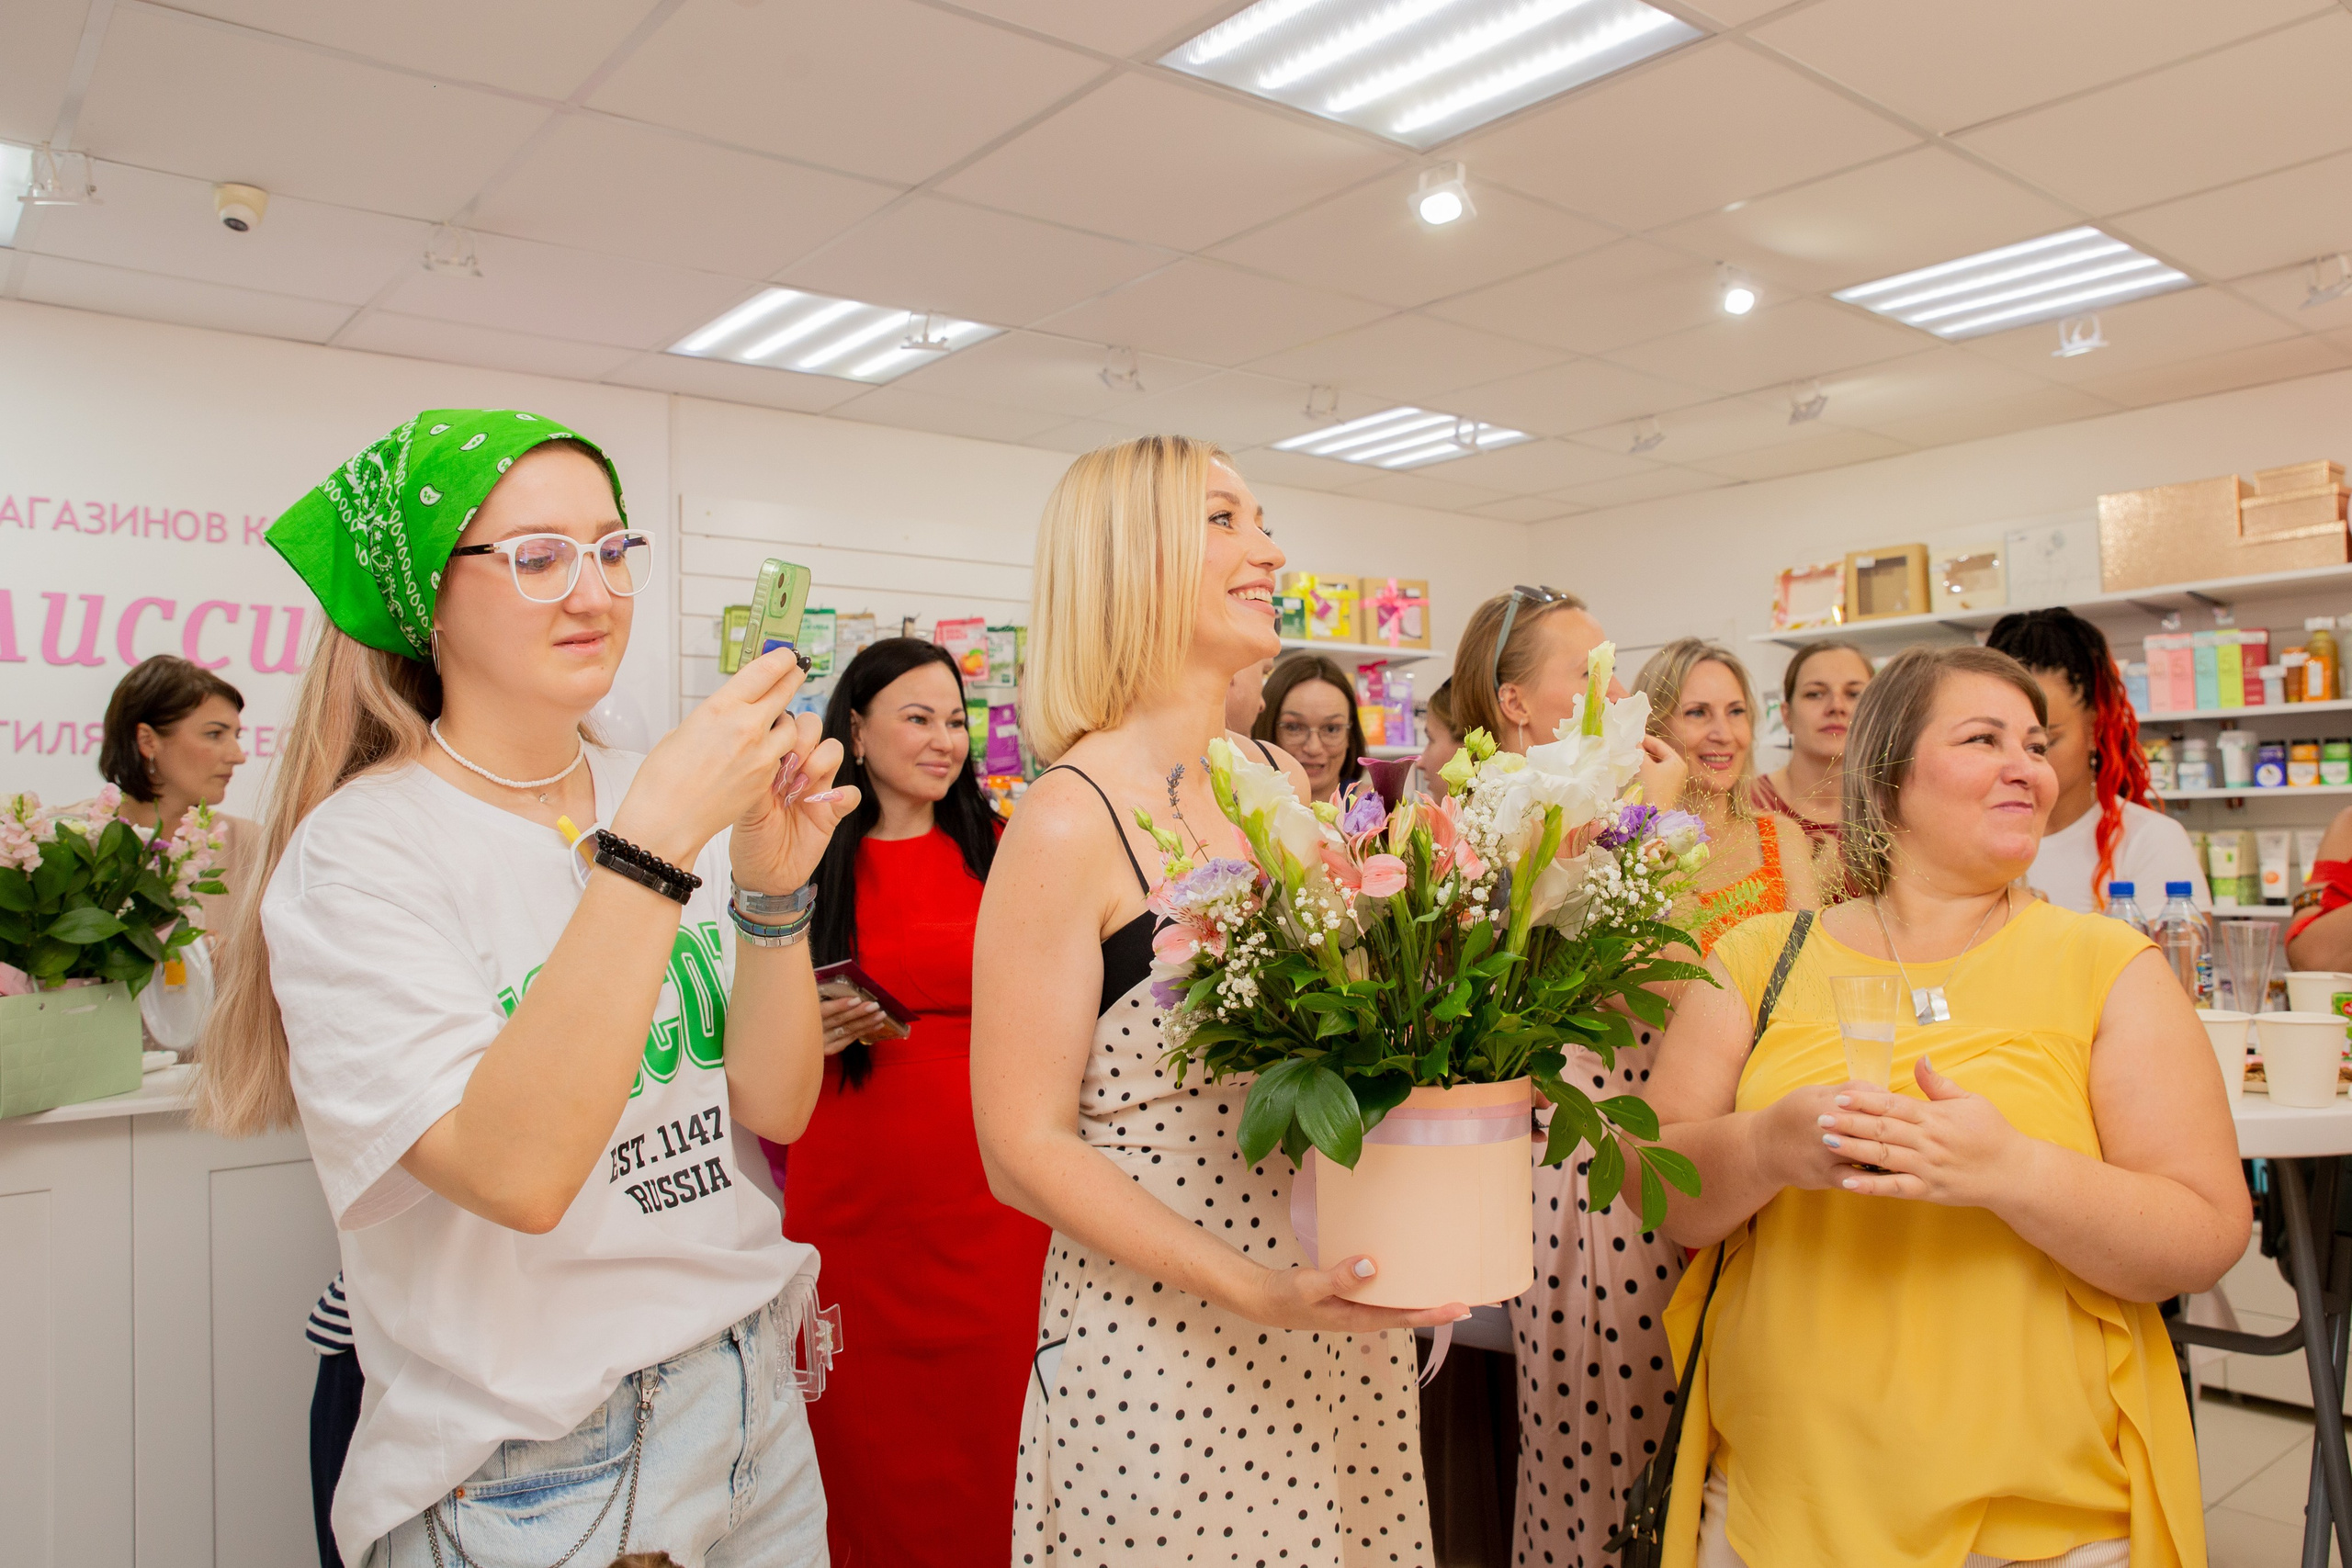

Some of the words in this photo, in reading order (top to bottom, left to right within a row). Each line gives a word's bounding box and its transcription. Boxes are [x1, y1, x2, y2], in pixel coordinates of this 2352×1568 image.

[243, 514, 276, 547] К
[0, 719, 105, 755] ИЛЯ
[625, 1156, 732, 1213] RUSSIA
